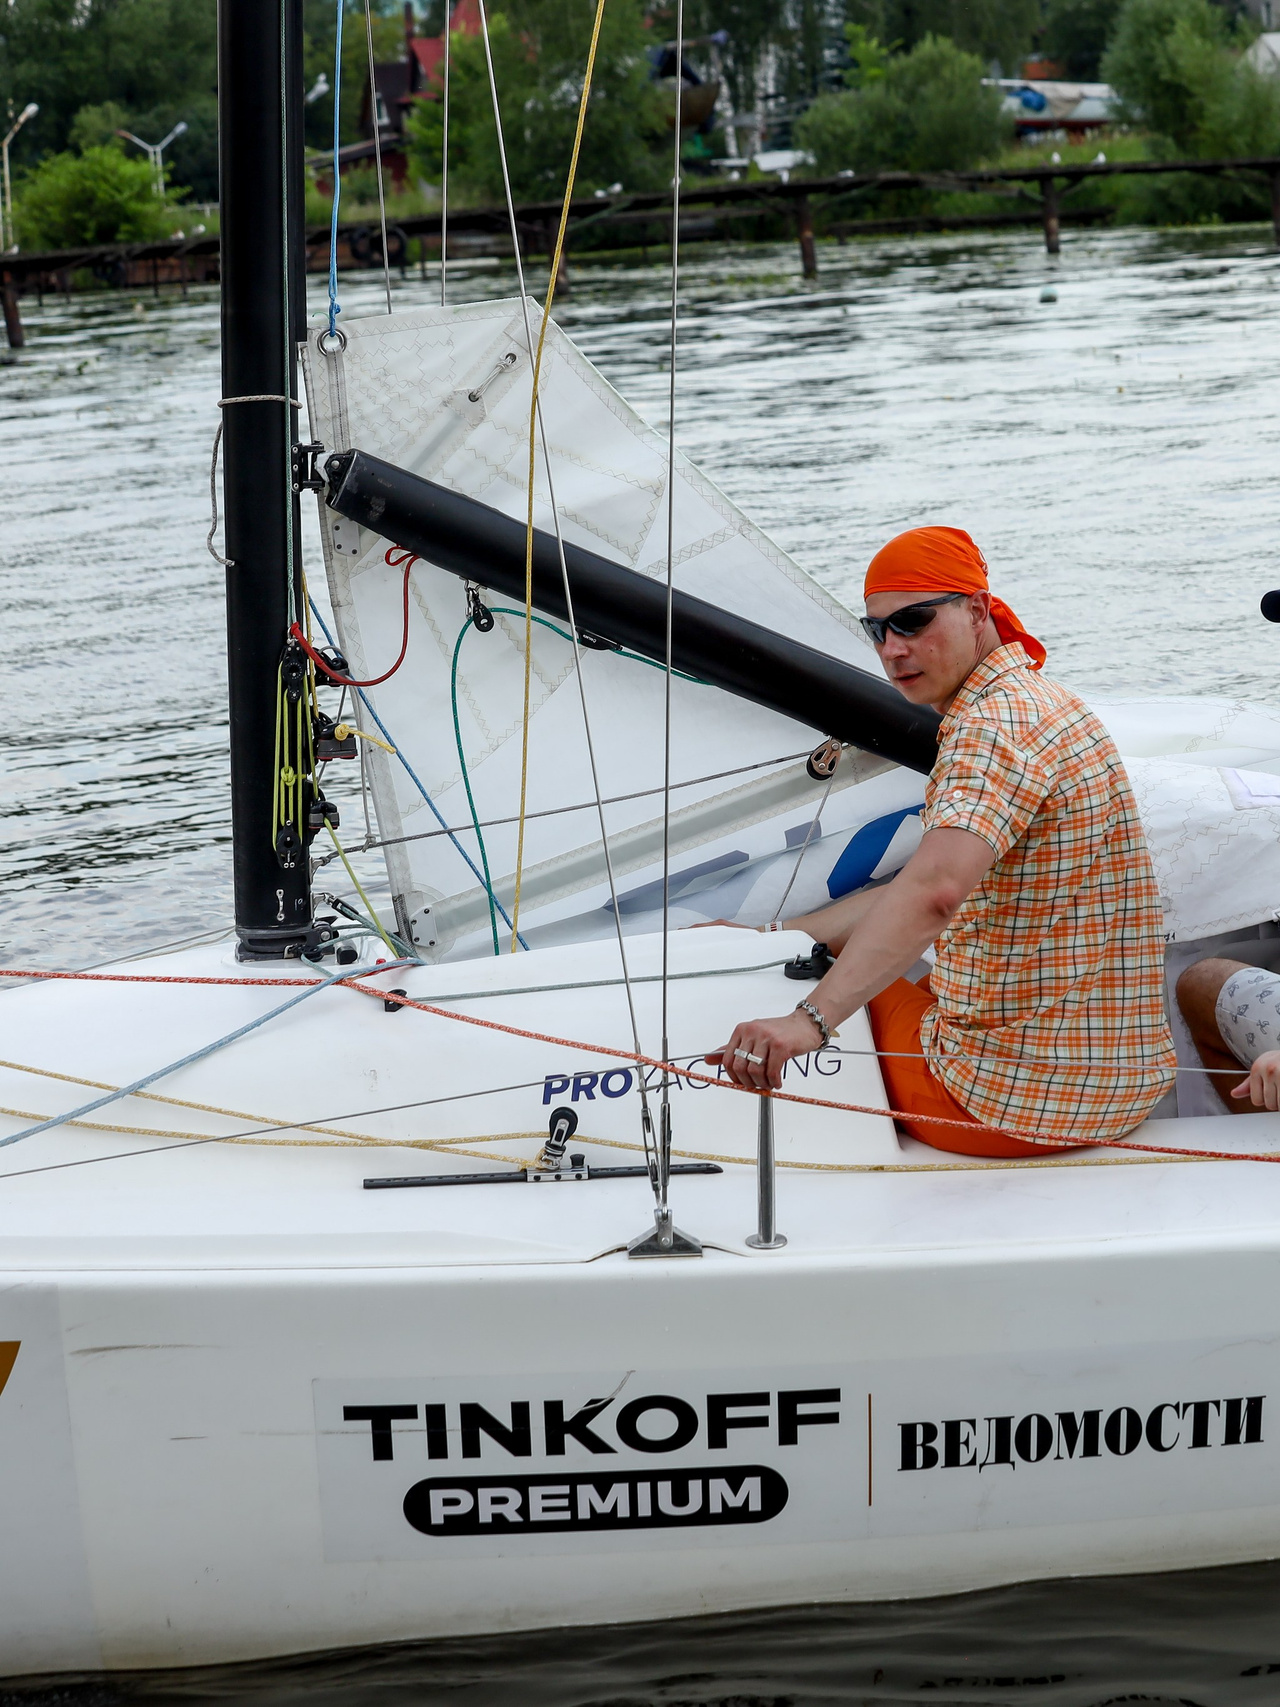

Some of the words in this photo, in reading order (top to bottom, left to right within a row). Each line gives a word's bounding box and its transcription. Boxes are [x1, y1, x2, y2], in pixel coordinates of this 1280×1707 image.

[343, 1388, 841, 1461] TINKOFF
[897, 1395, 1266, 1473] ВЕДОМОСТИ
[429, 1476, 762, 1525] PREMIUM
